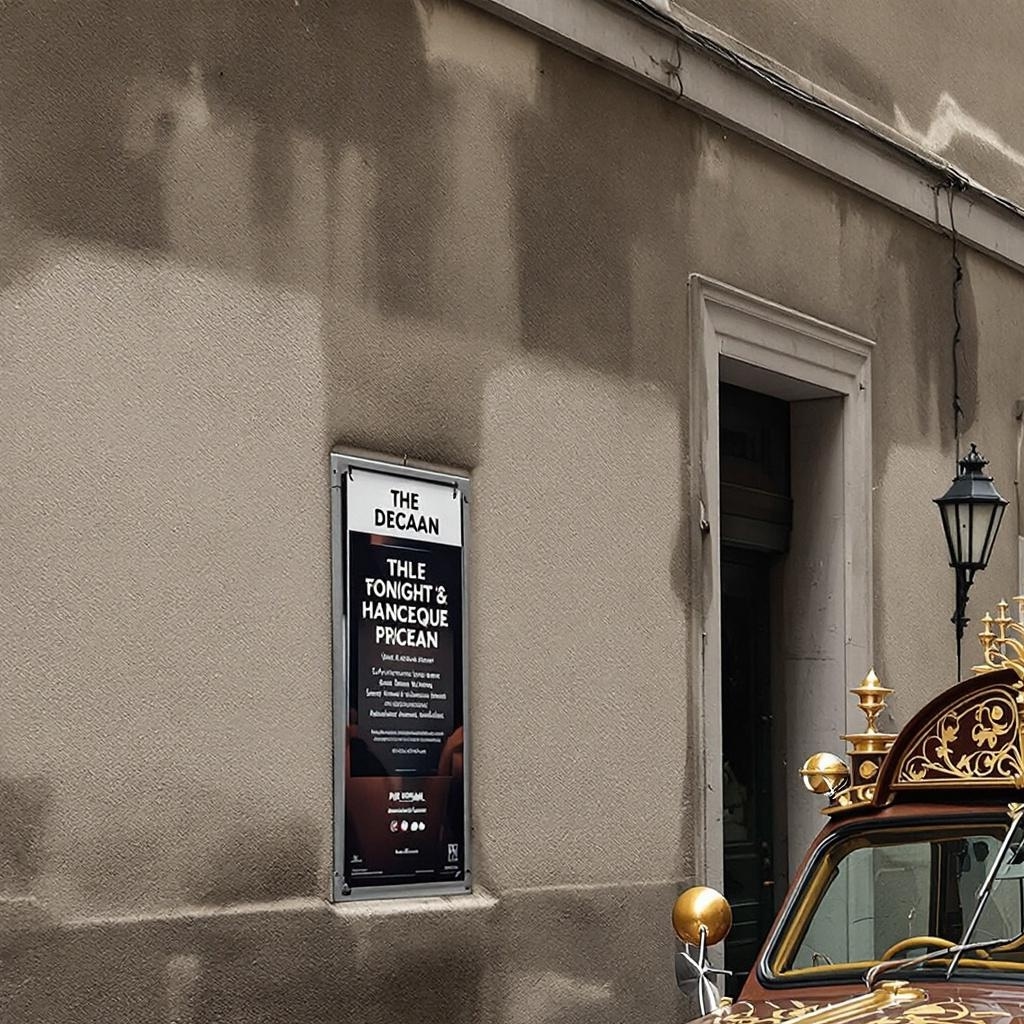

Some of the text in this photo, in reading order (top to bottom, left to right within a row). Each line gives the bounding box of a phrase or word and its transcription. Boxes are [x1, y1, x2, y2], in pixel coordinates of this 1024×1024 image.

[391, 489, 419, 510] THE
[375, 508, 440, 535] DECAAN
[386, 558, 426, 580] THLE
[362, 601, 449, 628] HANCEQUE
